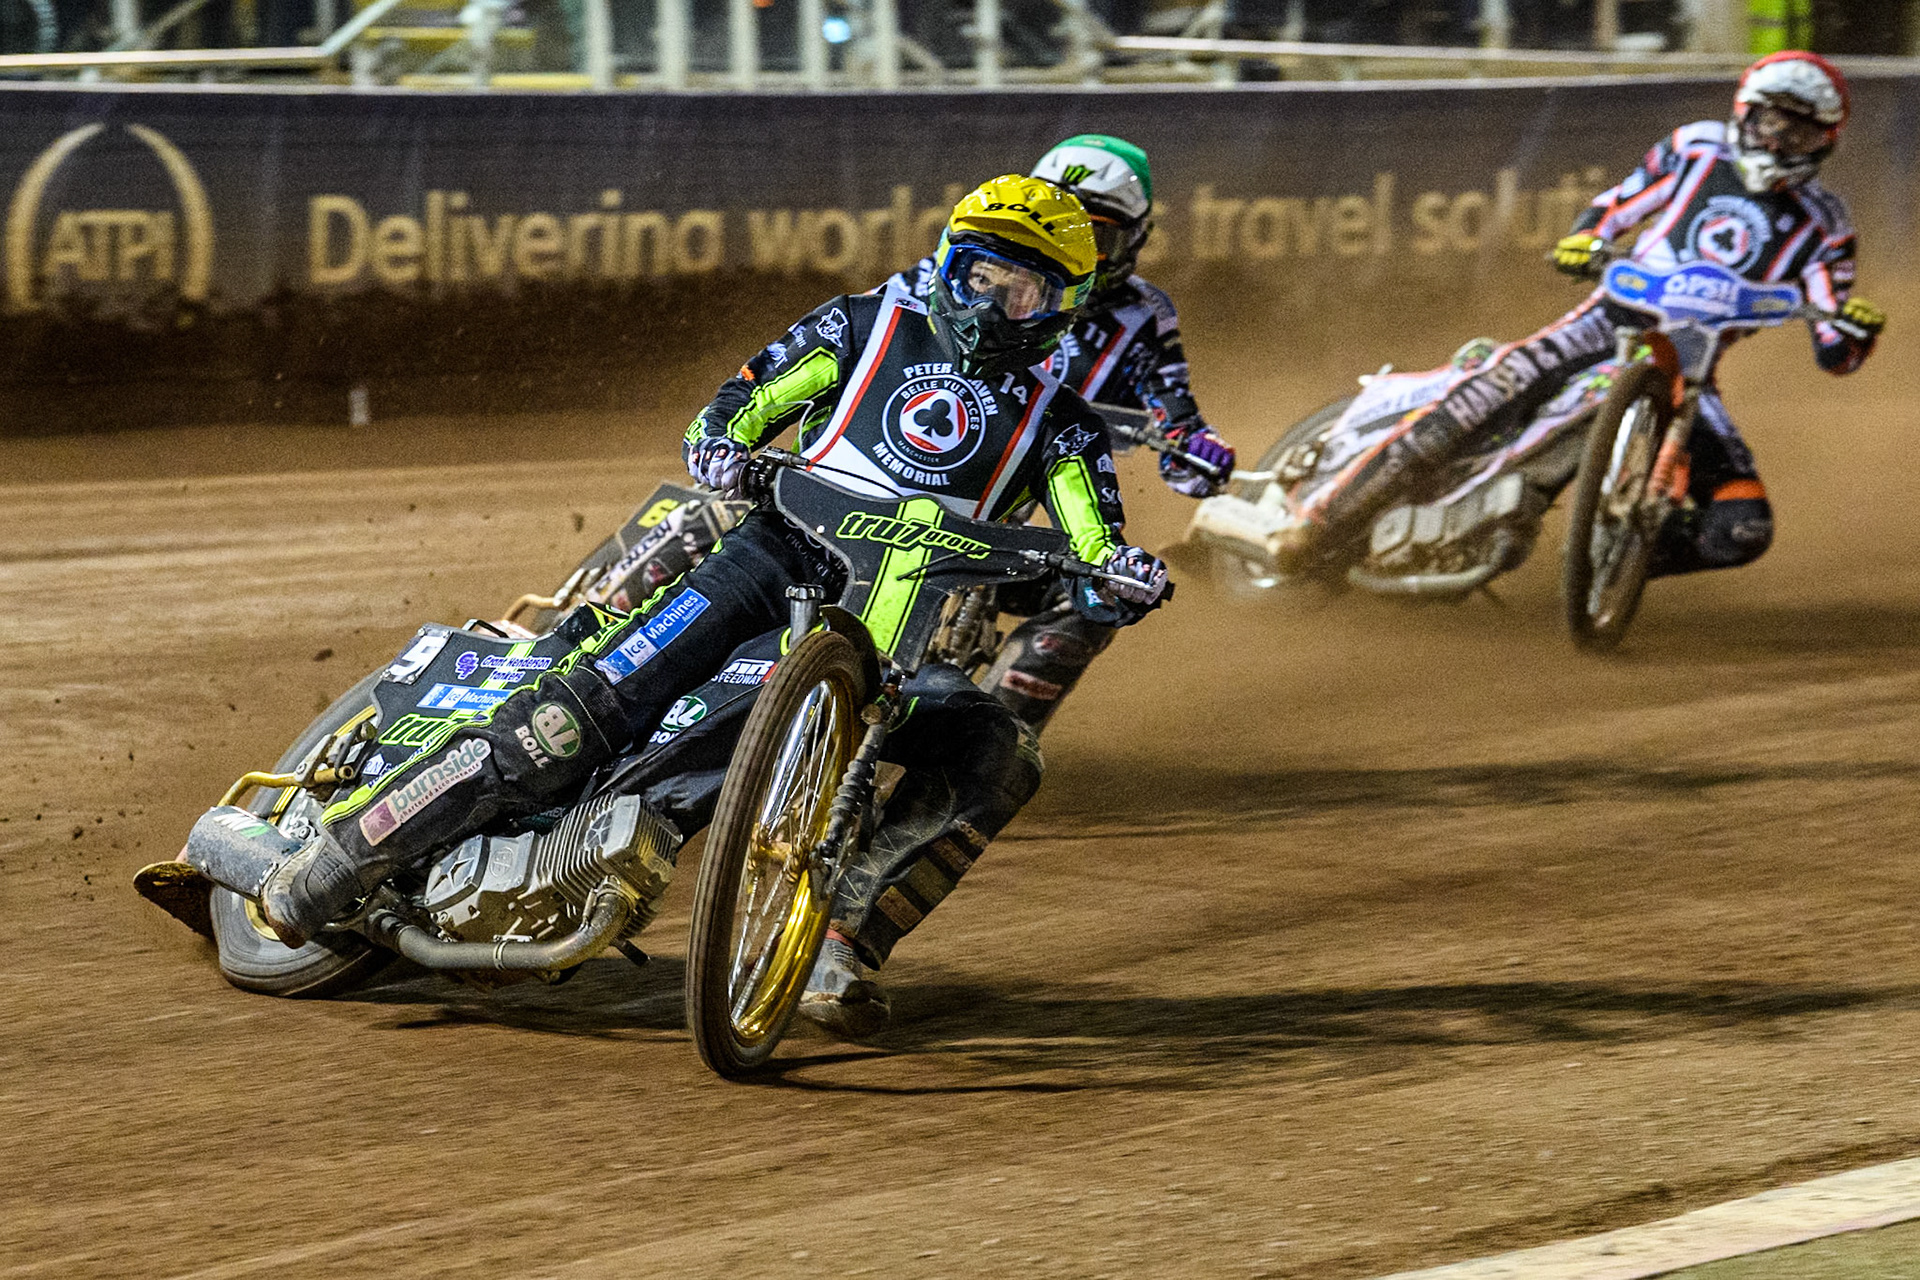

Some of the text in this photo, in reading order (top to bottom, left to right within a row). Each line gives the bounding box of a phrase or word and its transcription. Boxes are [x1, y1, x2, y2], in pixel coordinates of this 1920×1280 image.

[1192, 171, 1395, 261] travel
[1411, 166, 1606, 253] soluti
[44, 209, 175, 281] ATPI
[1083, 321, 1109, 350] 11
[902, 362, 954, 379] PETER
[999, 372, 1028, 405] 14
[900, 379, 980, 431] BELLE VUE ACES
[872, 441, 951, 486] MEMORIAL
[897, 439, 940, 463] MANCHESTER
[624, 593, 699, 658] Ice Machines
[481, 655, 506, 668] Grant
[506, 656, 552, 669] Henderson
[446, 692, 461, 704] Ice
[514, 725, 552, 768] BOLL
[391, 738, 488, 813] burnside
[399, 792, 434, 821] chartered
[434, 762, 481, 793] accountants
